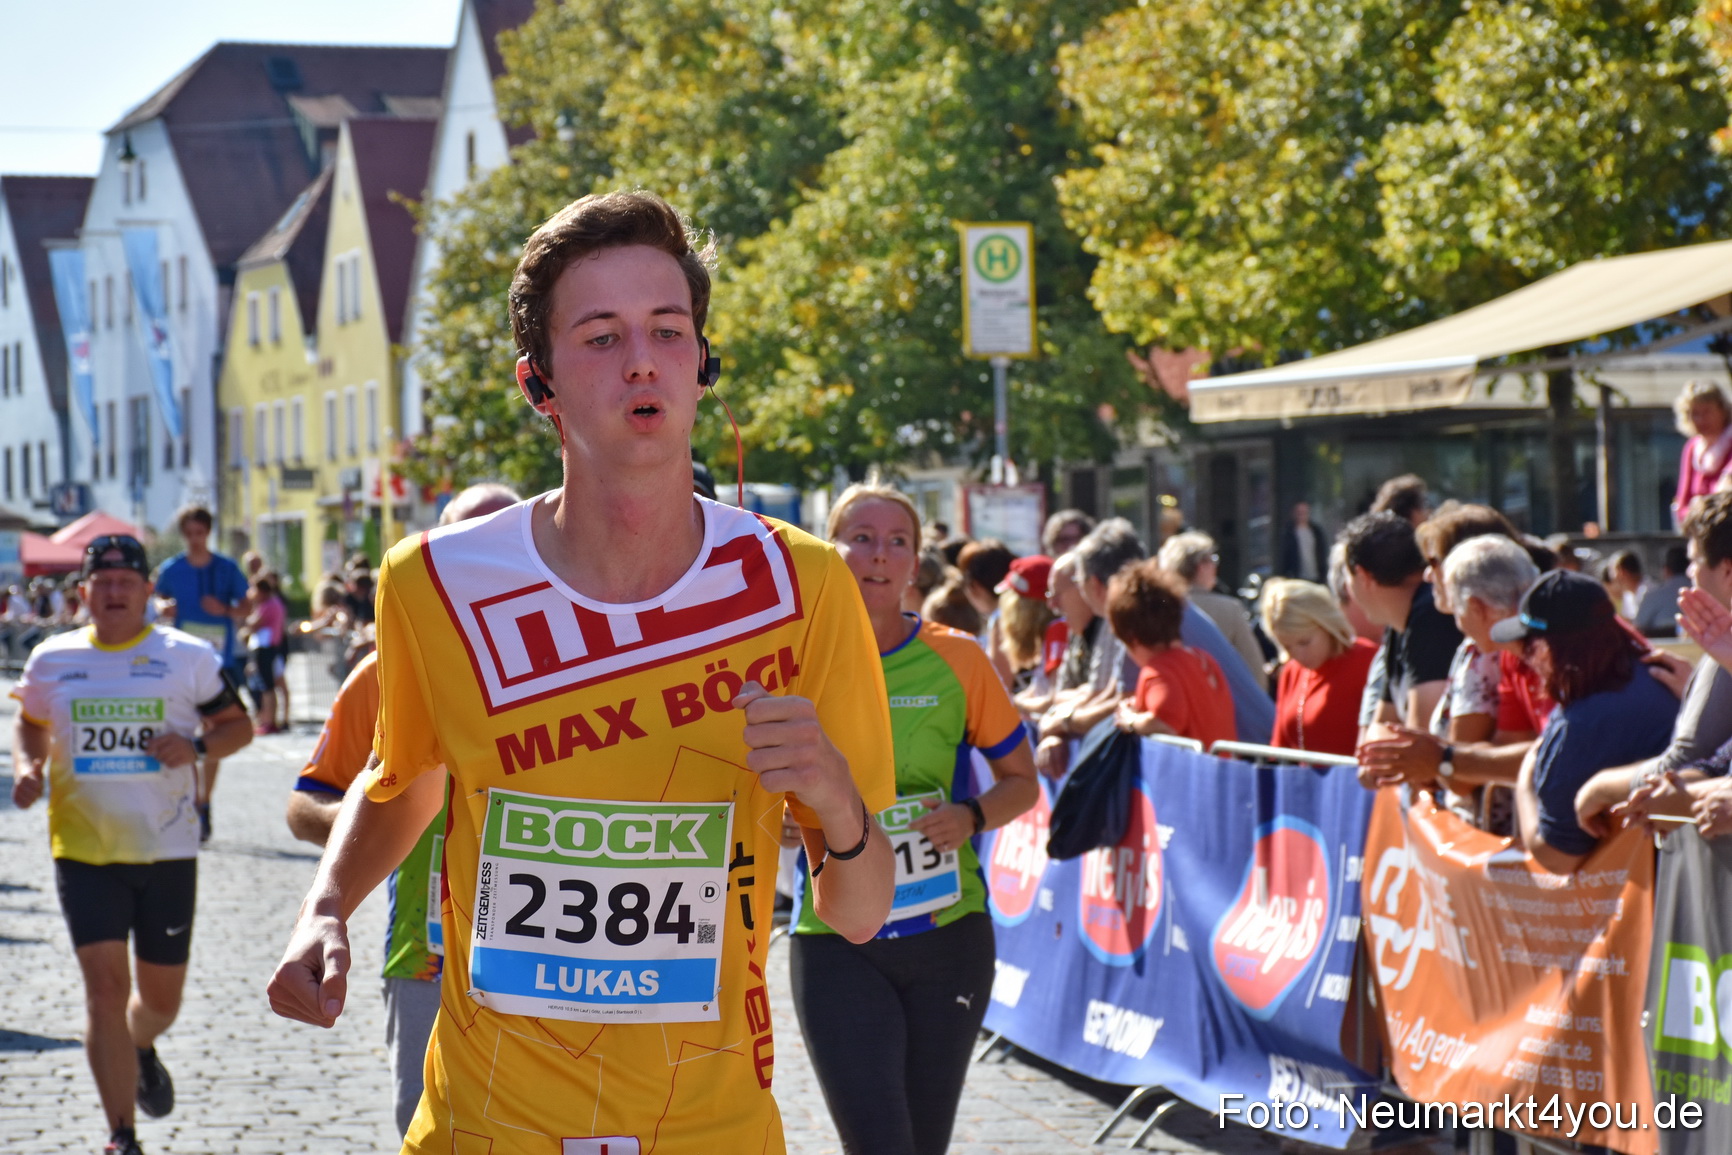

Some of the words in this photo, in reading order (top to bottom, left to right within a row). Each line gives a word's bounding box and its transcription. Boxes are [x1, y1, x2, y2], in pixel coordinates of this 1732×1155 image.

[78, 702, 156, 719] BOCK
[82, 727, 153, 751] 2048
[495, 698, 648, 776] MAX
[501, 803, 708, 859] BOCK
[705, 886, 715, 898] D
[505, 873, 695, 946] 2384
[535, 963, 660, 996] LUKAS
